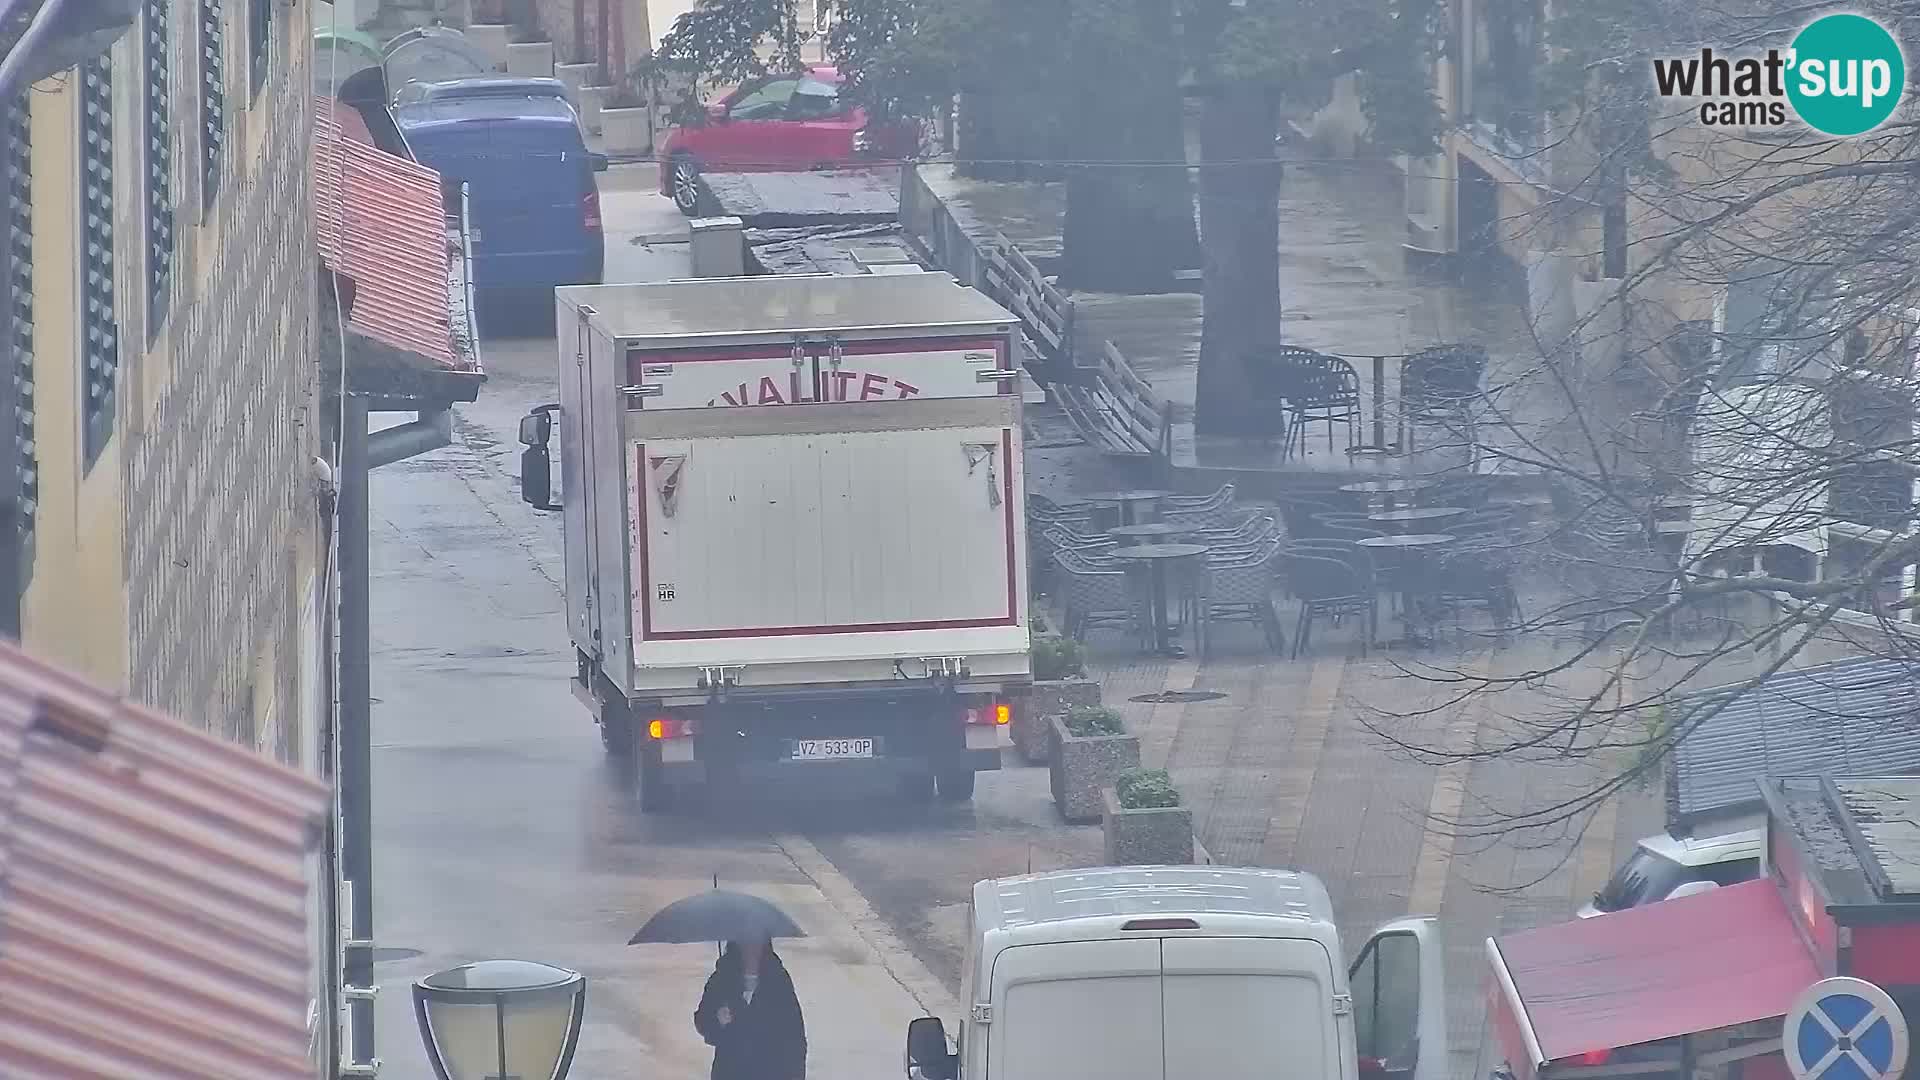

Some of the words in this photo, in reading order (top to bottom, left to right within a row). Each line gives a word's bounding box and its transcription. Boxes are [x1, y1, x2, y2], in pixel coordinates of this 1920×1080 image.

[707, 370, 920, 407] VALITET
[658, 590, 675, 600] HR
[800, 742, 816, 755] VZ
